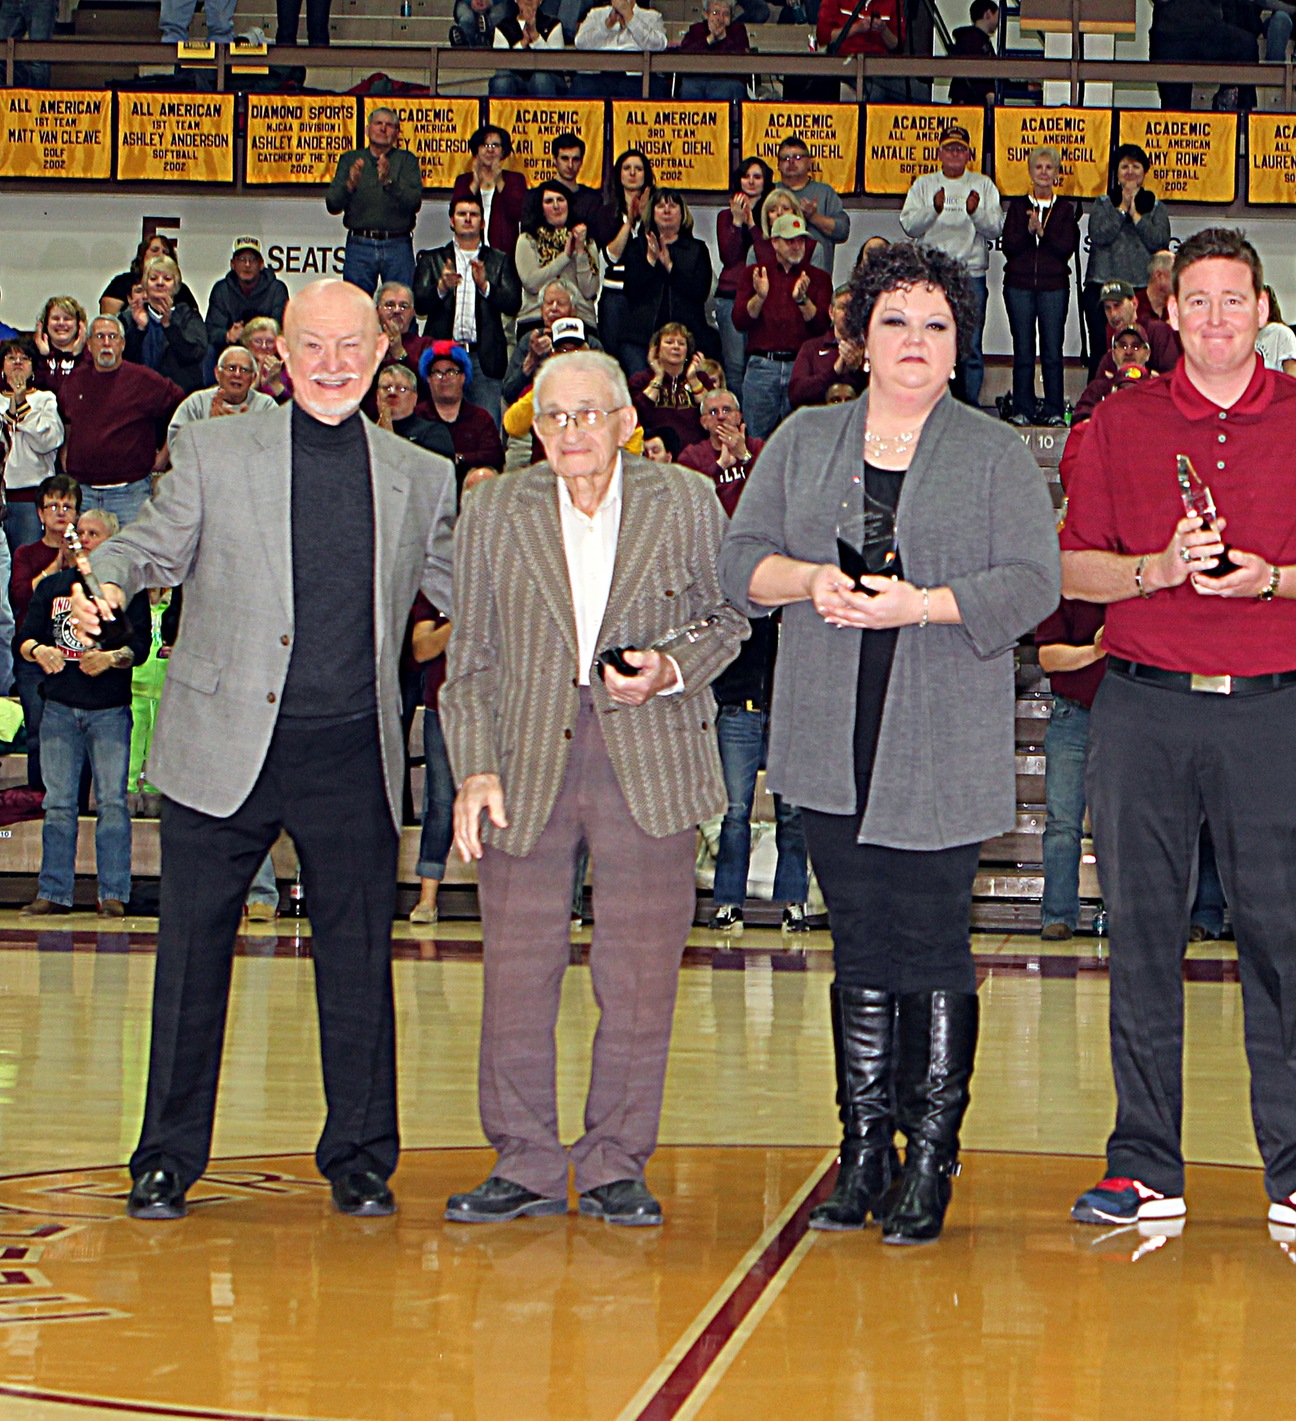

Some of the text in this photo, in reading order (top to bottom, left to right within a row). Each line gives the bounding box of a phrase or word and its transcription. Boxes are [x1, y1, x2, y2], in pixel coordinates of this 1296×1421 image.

[9, 99, 101, 115] ALL AMERICAN
[132, 102, 221, 117] ALL AMERICAN
[251, 106, 353, 119] DIAMOND SPORTS
[515, 110, 579, 124] ACADEMIC
[35, 118, 77, 127] 1ST TEAM
[626, 112, 716, 125] ALL AMERICAN
[769, 114, 833, 128] ACADEMIC
[152, 121, 200, 130] 1ST TEAM
[267, 123, 293, 132] NJCAA
[300, 124, 335, 132] DIVISION
[414, 124, 457, 133] AMERICAN
[512, 125, 582, 135] ALL AMERICAN
[1021, 119, 1085, 132] ACADEMIC
[1145, 122, 1211, 136] ACADEMIC
[8, 129, 101, 145] MATT VAN CLEAVE
[648, 129, 695, 138] 3RD TEAM
[765, 129, 836, 140] ALL AMERICAN
[889, 131, 905, 140] ALL
[916, 132, 939, 141] AMER
[123, 133, 228, 148] ASHLEY ANDERSON
[252, 136, 353, 150] ASHLEY ANDERSON
[1021, 135, 1085, 144] ALL AMERICAN
[1145, 140, 1210, 149] ALL AMERICAN
[44, 149, 65, 157] GOLF
[683, 142, 714, 155] DIEHL
[810, 144, 843, 158] DIEHL
[872, 146, 915, 160] NATALIE
[1275, 144, 1291, 152] ALL
[153, 150, 198, 160] SOFTBALL
[258, 153, 338, 163] CATCHER OF THE YE
[1062, 149, 1096, 163] McGILL
[1176, 153, 1206, 167] ROWE
[43, 160, 66, 169] 2002
[164, 163, 186, 172] 2002
[290, 165, 313, 174] 2002
[660, 172, 682, 180] 2002
[1154, 170, 1199, 180] SOFTBALL
[1165, 182, 1187, 191] 2002
[267, 246, 346, 273] SEATS
[1039, 434, 1055, 449] 10
